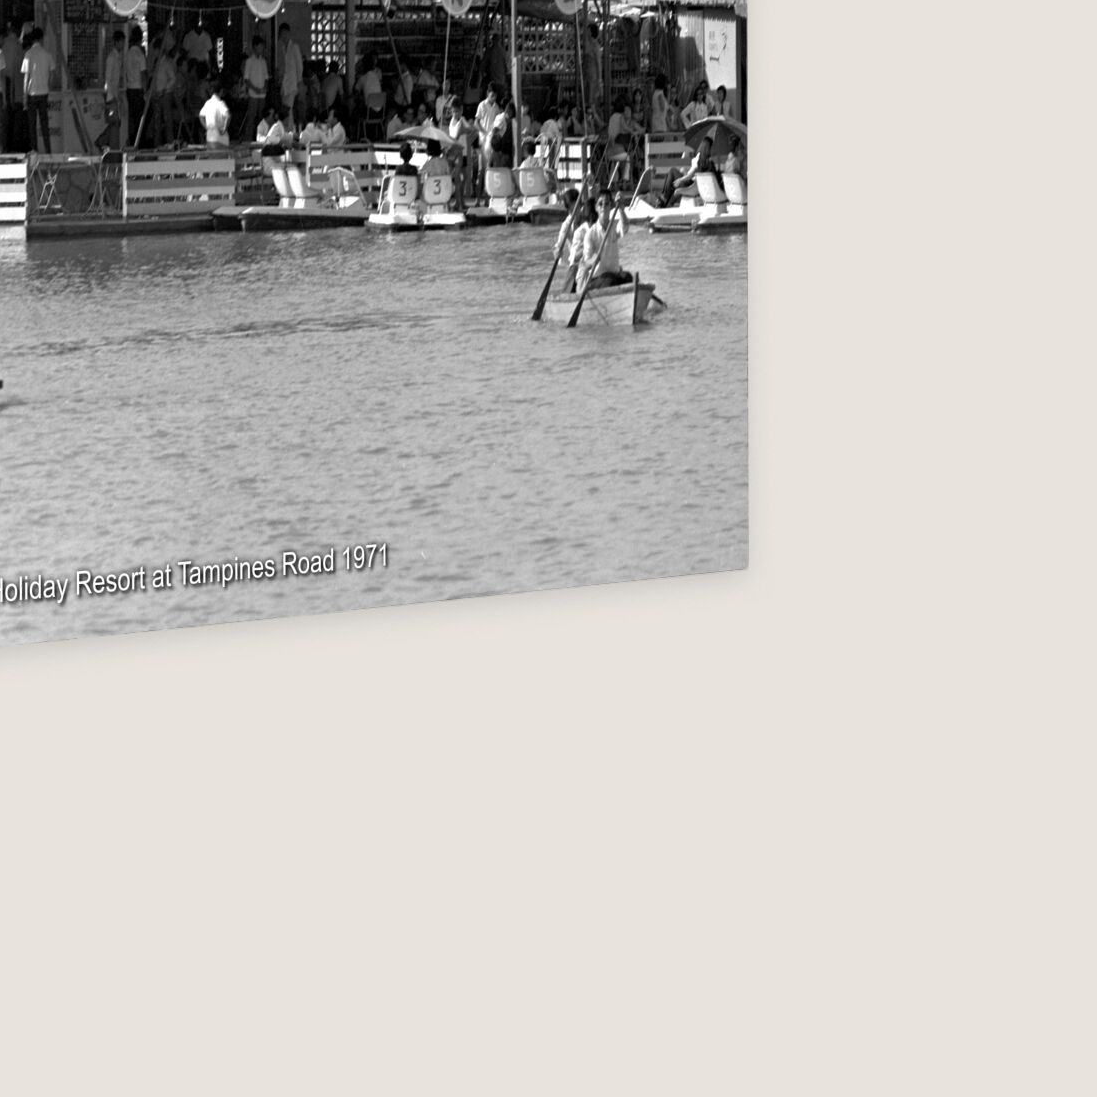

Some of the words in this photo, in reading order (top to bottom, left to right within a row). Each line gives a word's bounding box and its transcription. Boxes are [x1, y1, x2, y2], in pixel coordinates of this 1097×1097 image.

[433, 179, 441, 195] 3
[493, 172, 501, 188] 5
[526, 172, 535, 188] 5
[398, 181, 407, 197] 3
